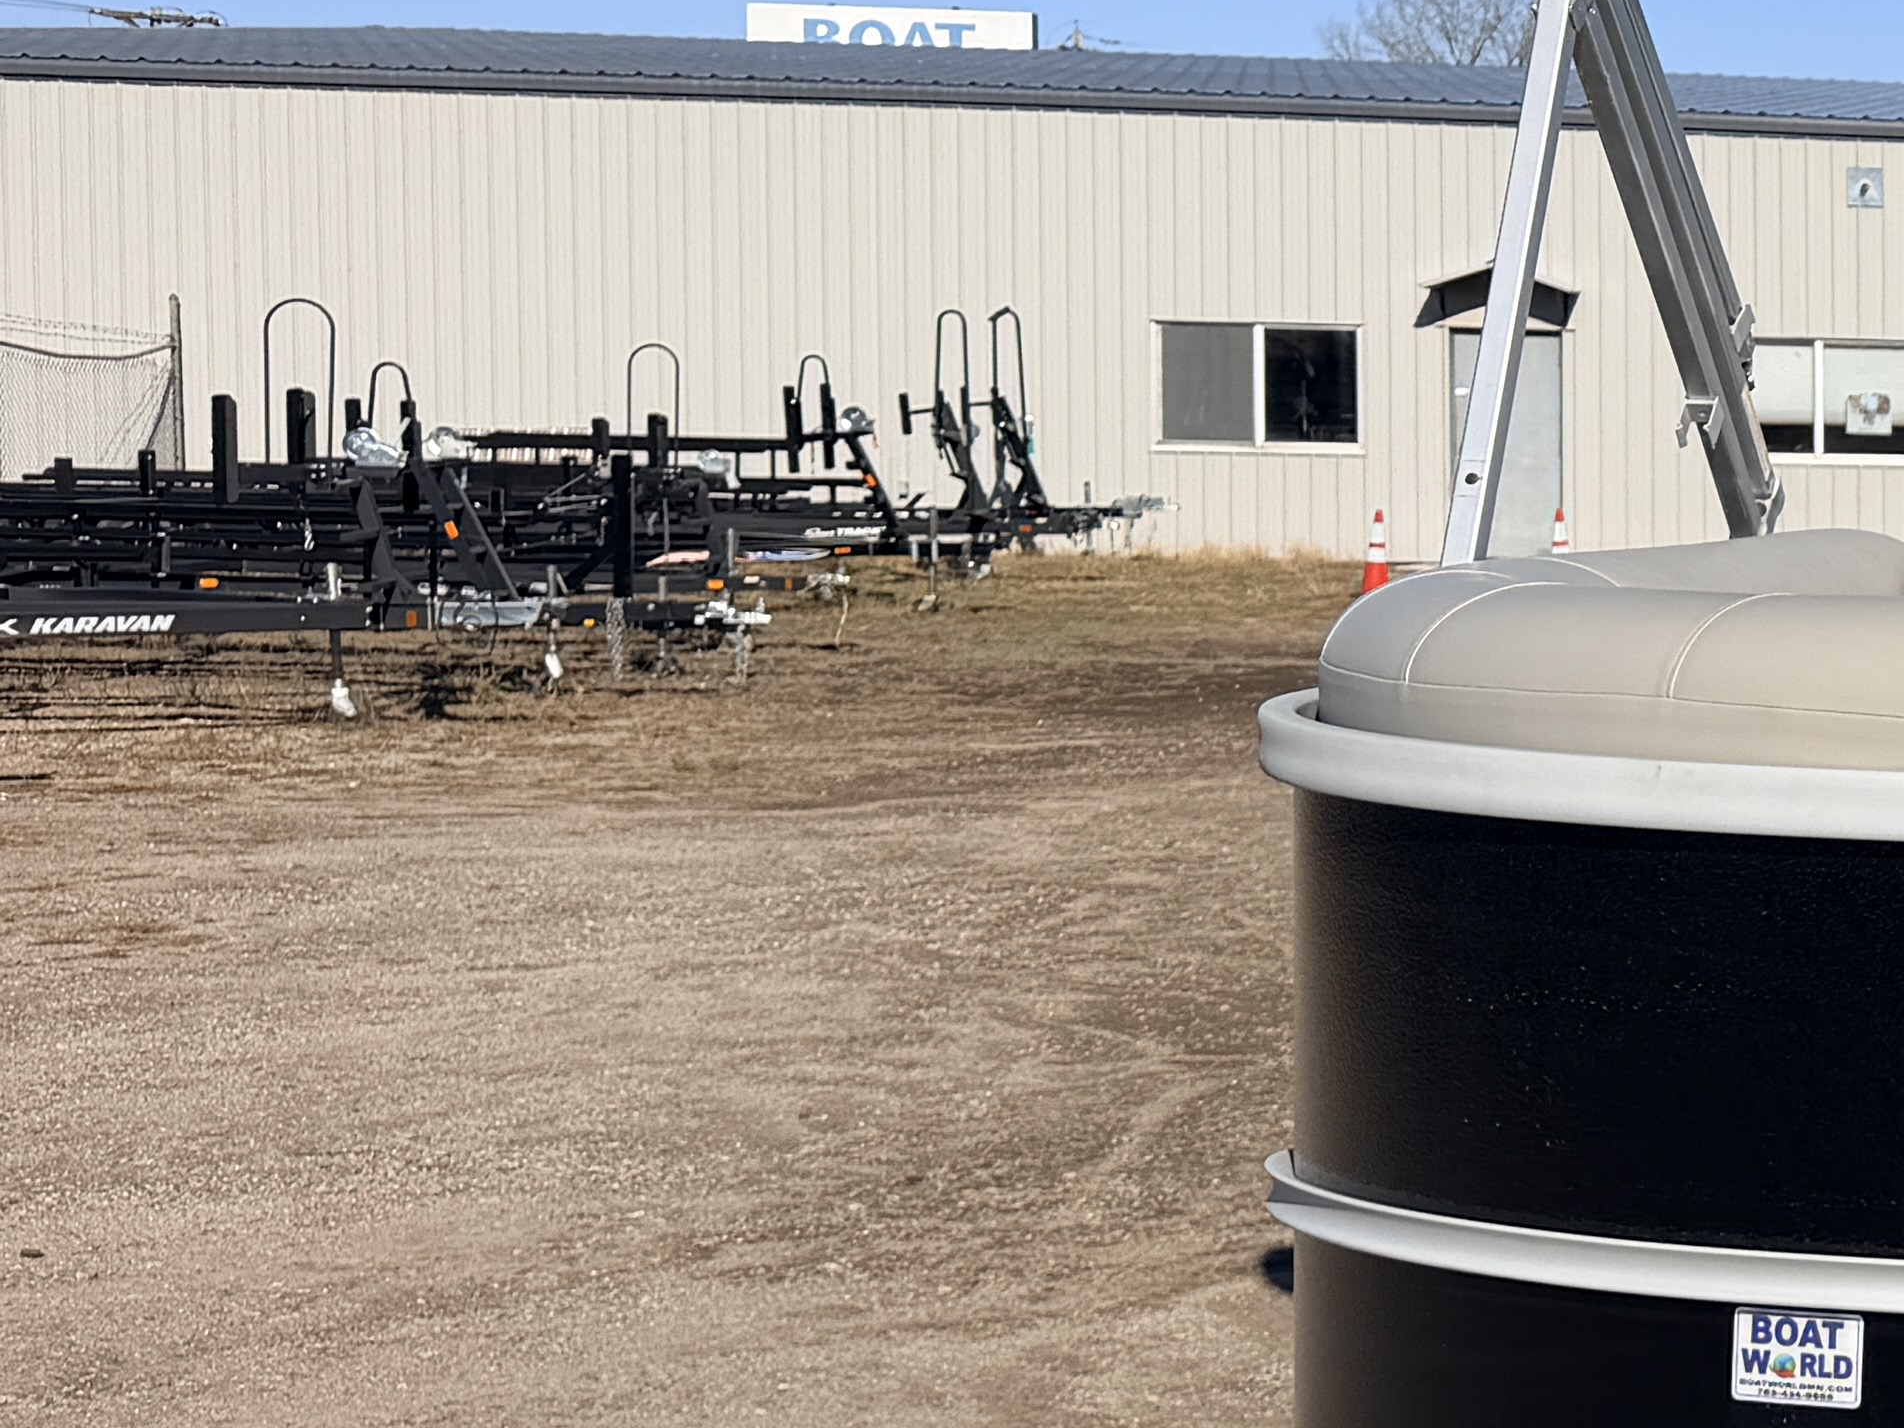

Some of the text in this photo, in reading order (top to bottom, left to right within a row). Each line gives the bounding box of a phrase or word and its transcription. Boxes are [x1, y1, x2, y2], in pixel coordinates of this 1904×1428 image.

[803, 18, 976, 47] BOAT
[29, 614, 176, 634] KARAVAN
[1750, 1313, 1845, 1349] BOAT
